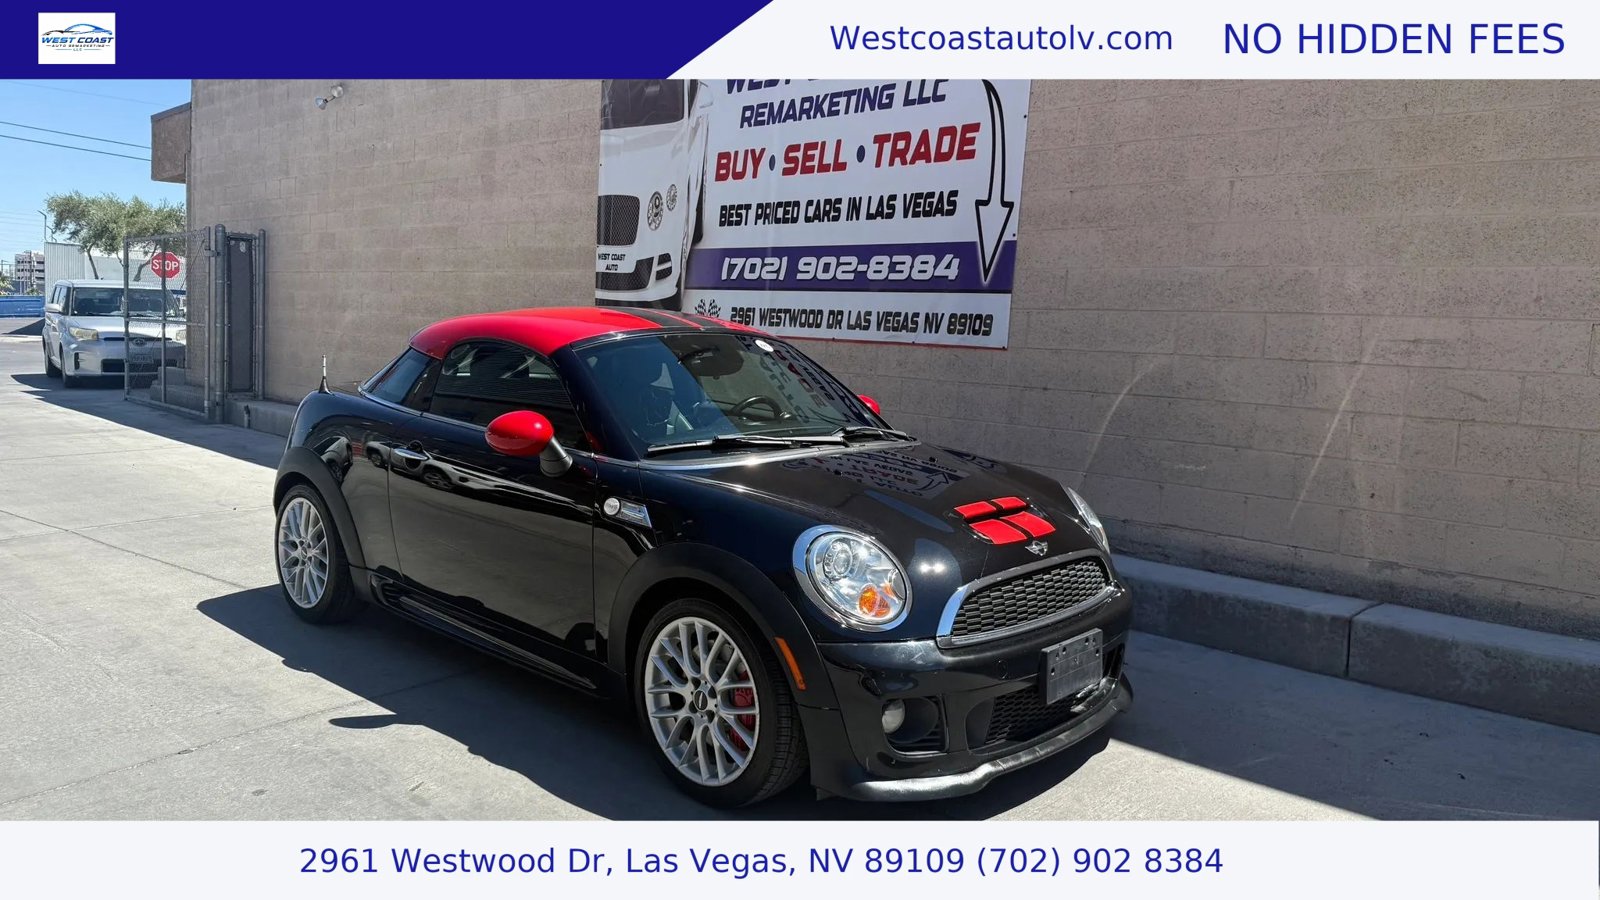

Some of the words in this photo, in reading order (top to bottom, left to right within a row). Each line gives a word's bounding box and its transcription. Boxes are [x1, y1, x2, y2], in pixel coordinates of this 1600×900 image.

[740, 83, 896, 129] REMARKETING
[903, 79, 949, 107] LLC
[714, 147, 766, 182] BUY
[782, 139, 848, 176] SELL
[872, 122, 981, 168] TRADE
[719, 204, 752, 227] BEST
[754, 200, 800, 226] PRICED
[804, 197, 842, 224] CARS
[845, 196, 863, 222] IN
[865, 194, 897, 220] LAS
[902, 190, 959, 219] VEGAS
[598, 253, 610, 261] WEST
[611, 253, 626, 261] COAST
[721, 256, 788, 281] (702)
[796, 254, 960, 281] 902-8384
[730, 306, 756, 326] 2961
[759, 307, 823, 329] WESTWOOD
[826, 310, 843, 330] DR
[847, 310, 872, 331] LAS
[875, 311, 919, 333] VEGAS
[923, 312, 944, 334] NV
[946, 313, 993, 336] 89109
